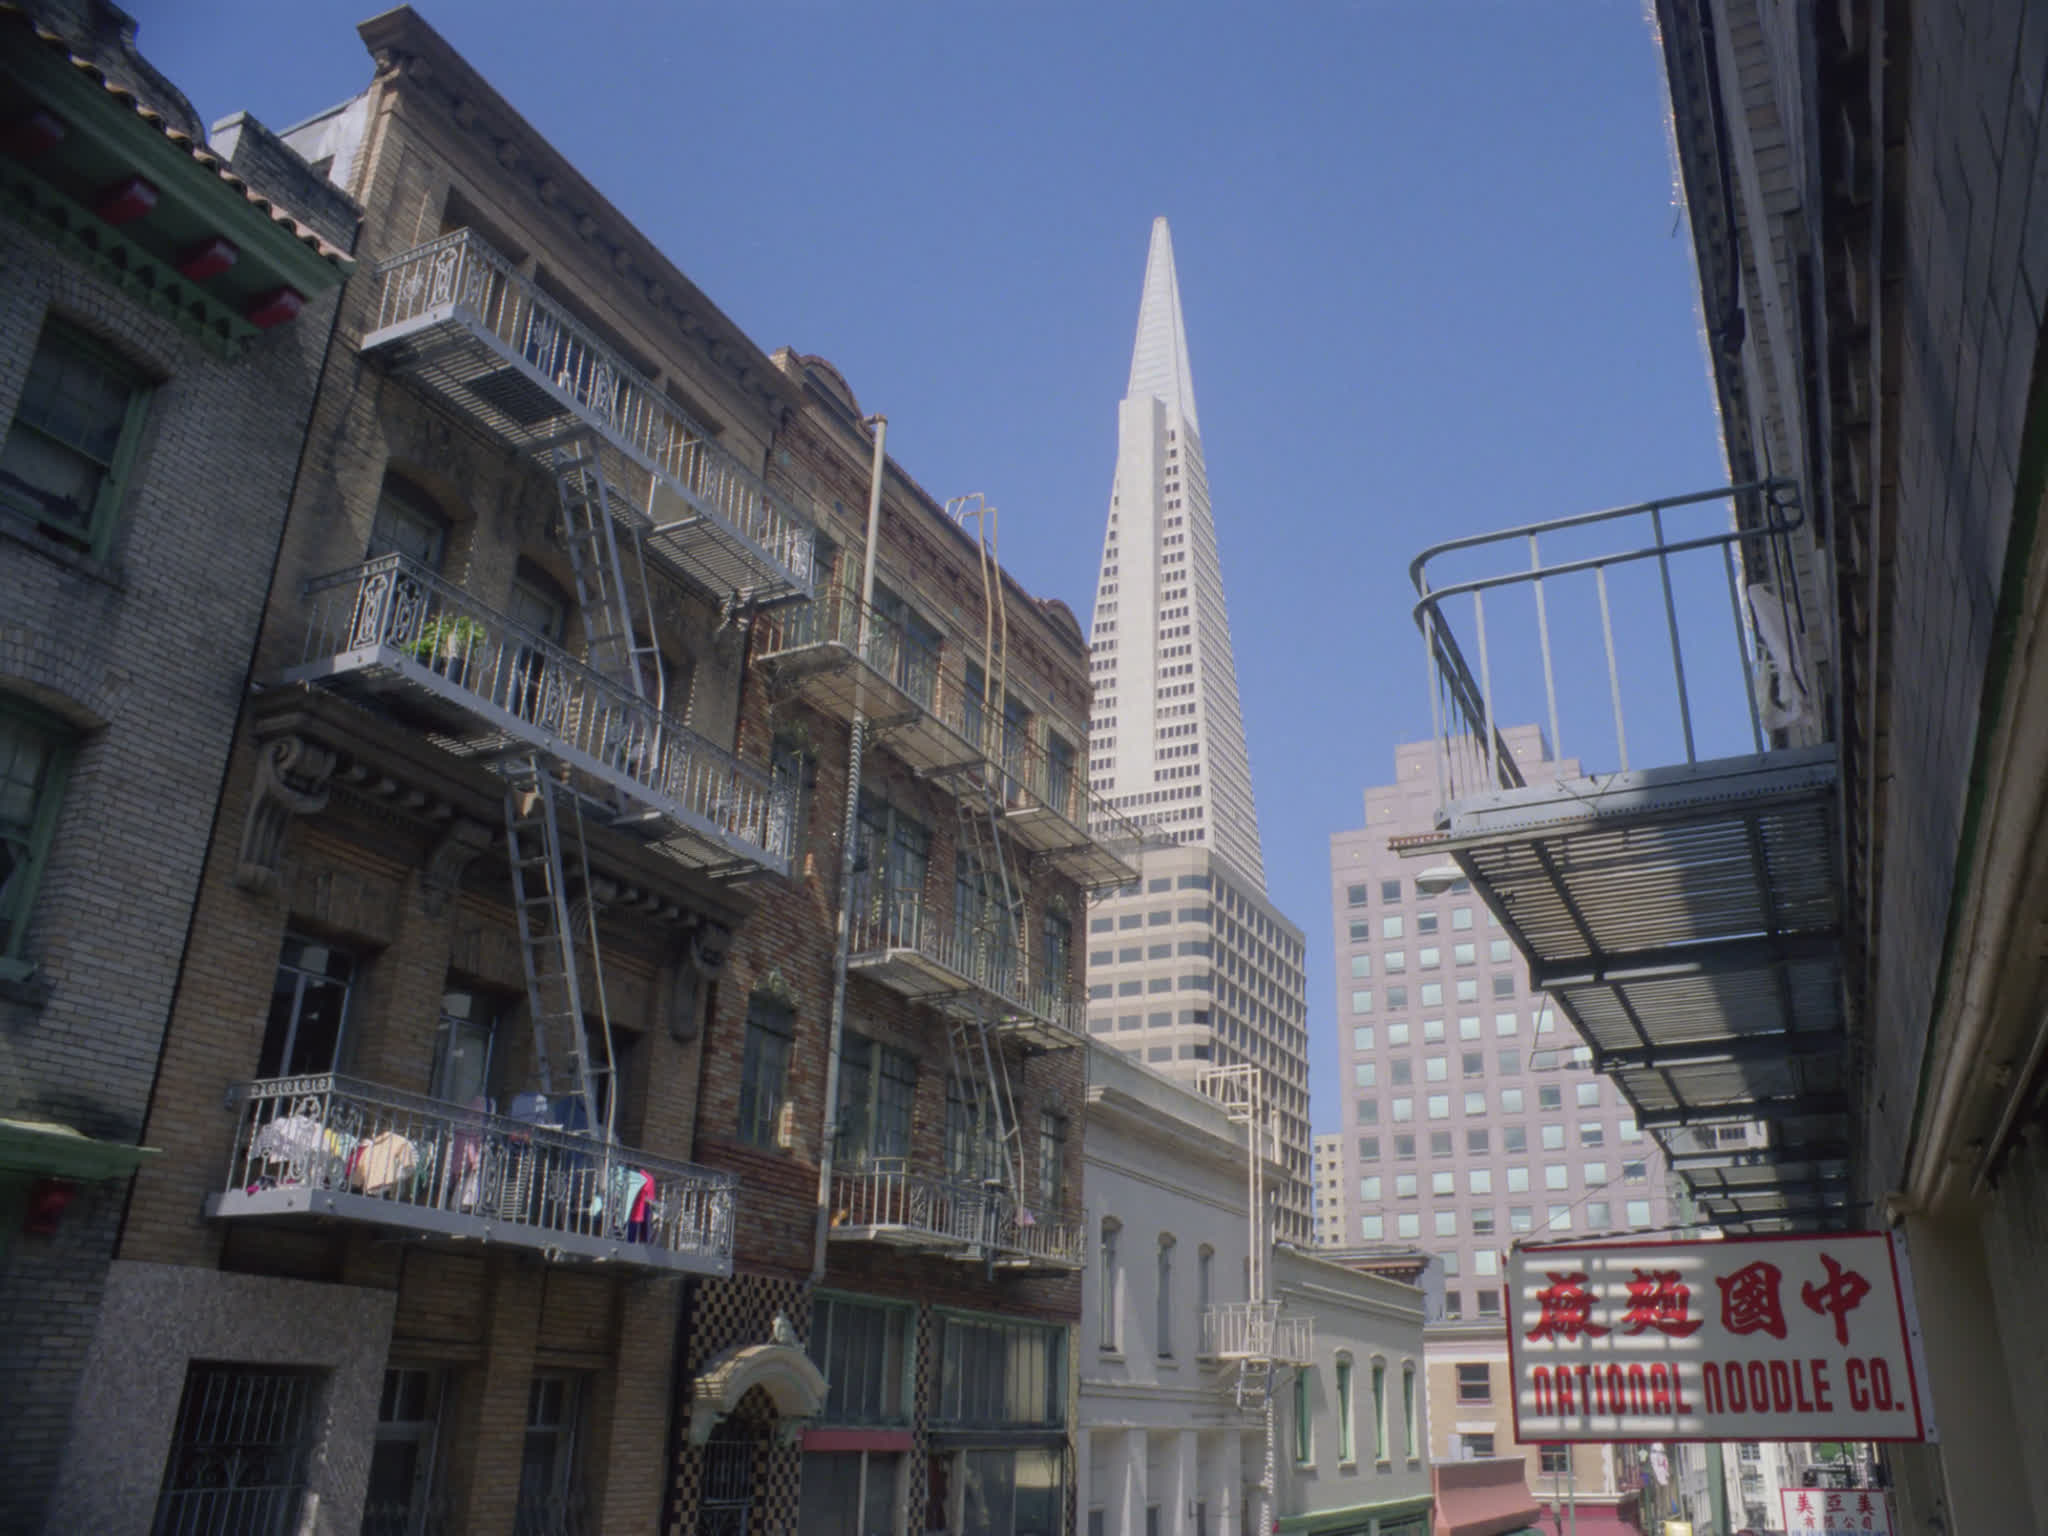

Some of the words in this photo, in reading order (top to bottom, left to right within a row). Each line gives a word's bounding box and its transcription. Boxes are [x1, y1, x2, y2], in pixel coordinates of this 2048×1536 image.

[1533, 1362, 1693, 1417] NATIONAL
[1702, 1358, 1833, 1414] NOODLE
[1845, 1357, 1905, 1412] CO.
